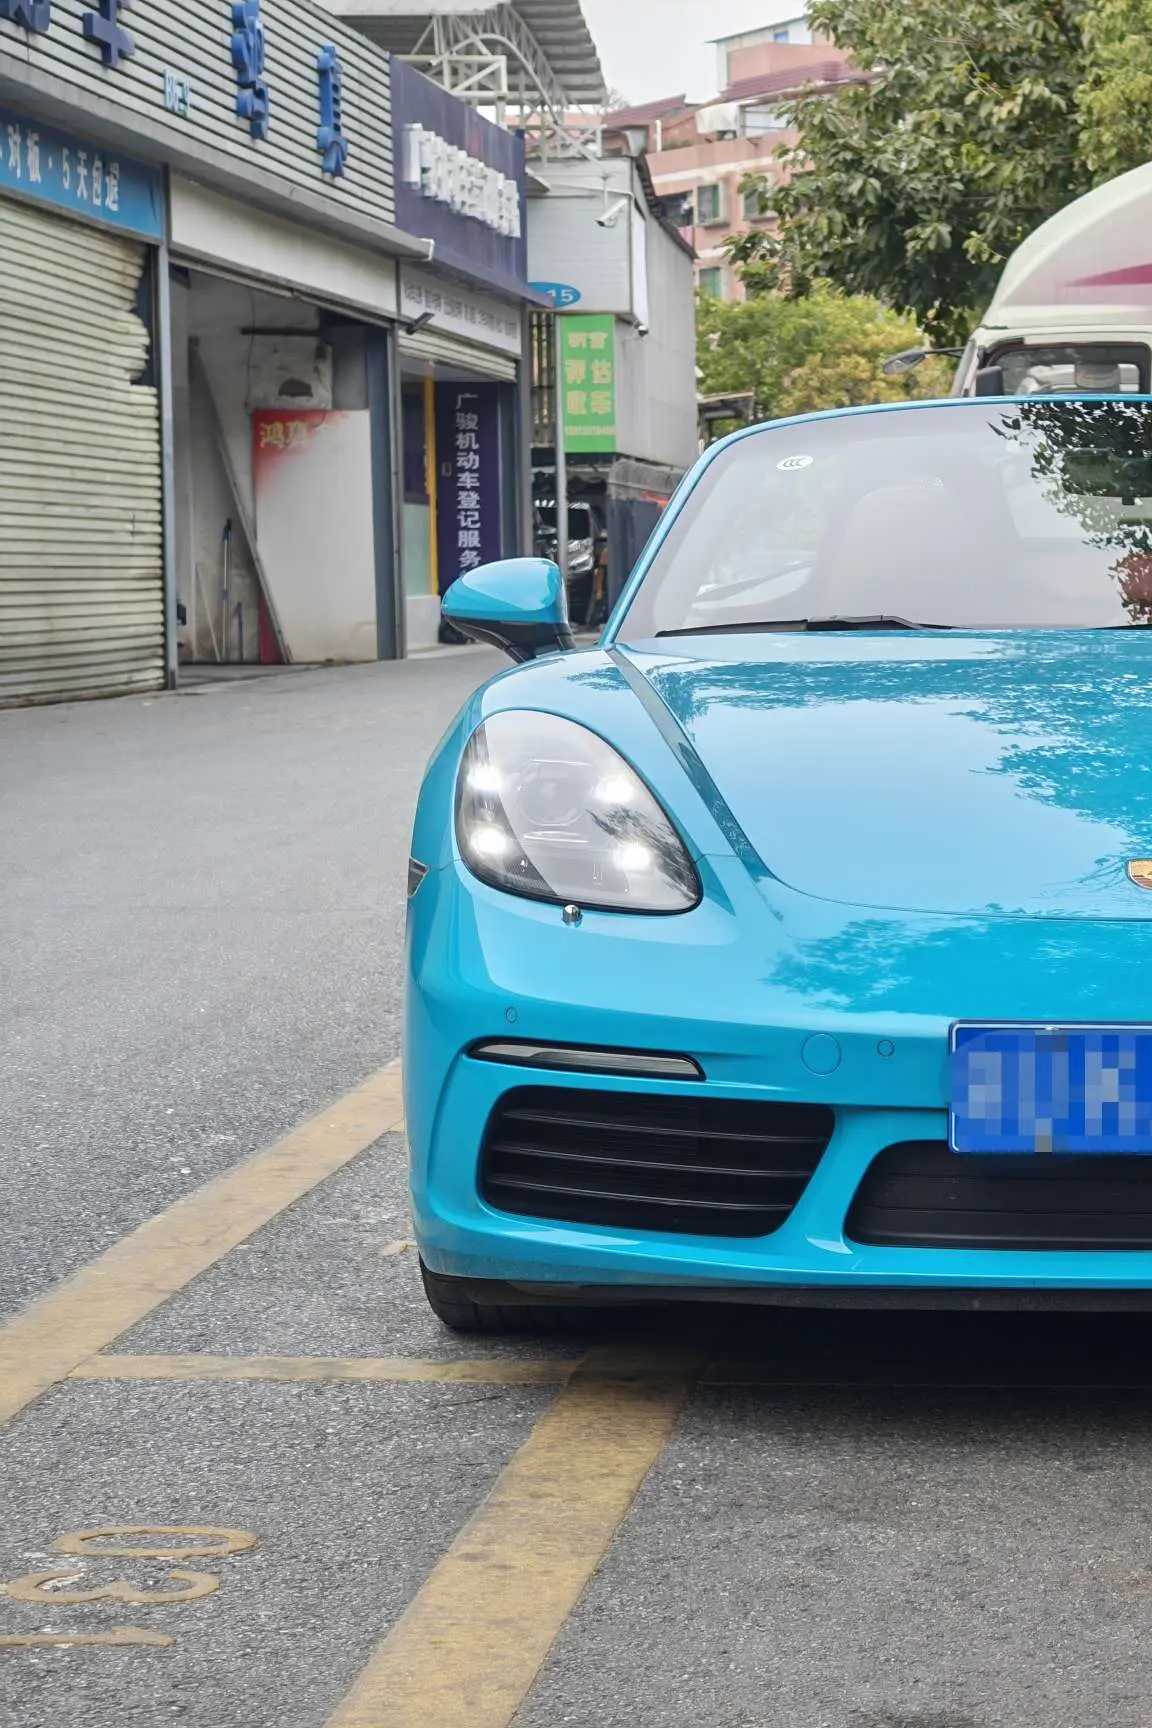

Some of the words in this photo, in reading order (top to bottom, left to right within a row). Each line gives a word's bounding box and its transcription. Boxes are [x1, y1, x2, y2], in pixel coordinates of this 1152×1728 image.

[455, 393, 482, 578] 广骏机动车登记服务
